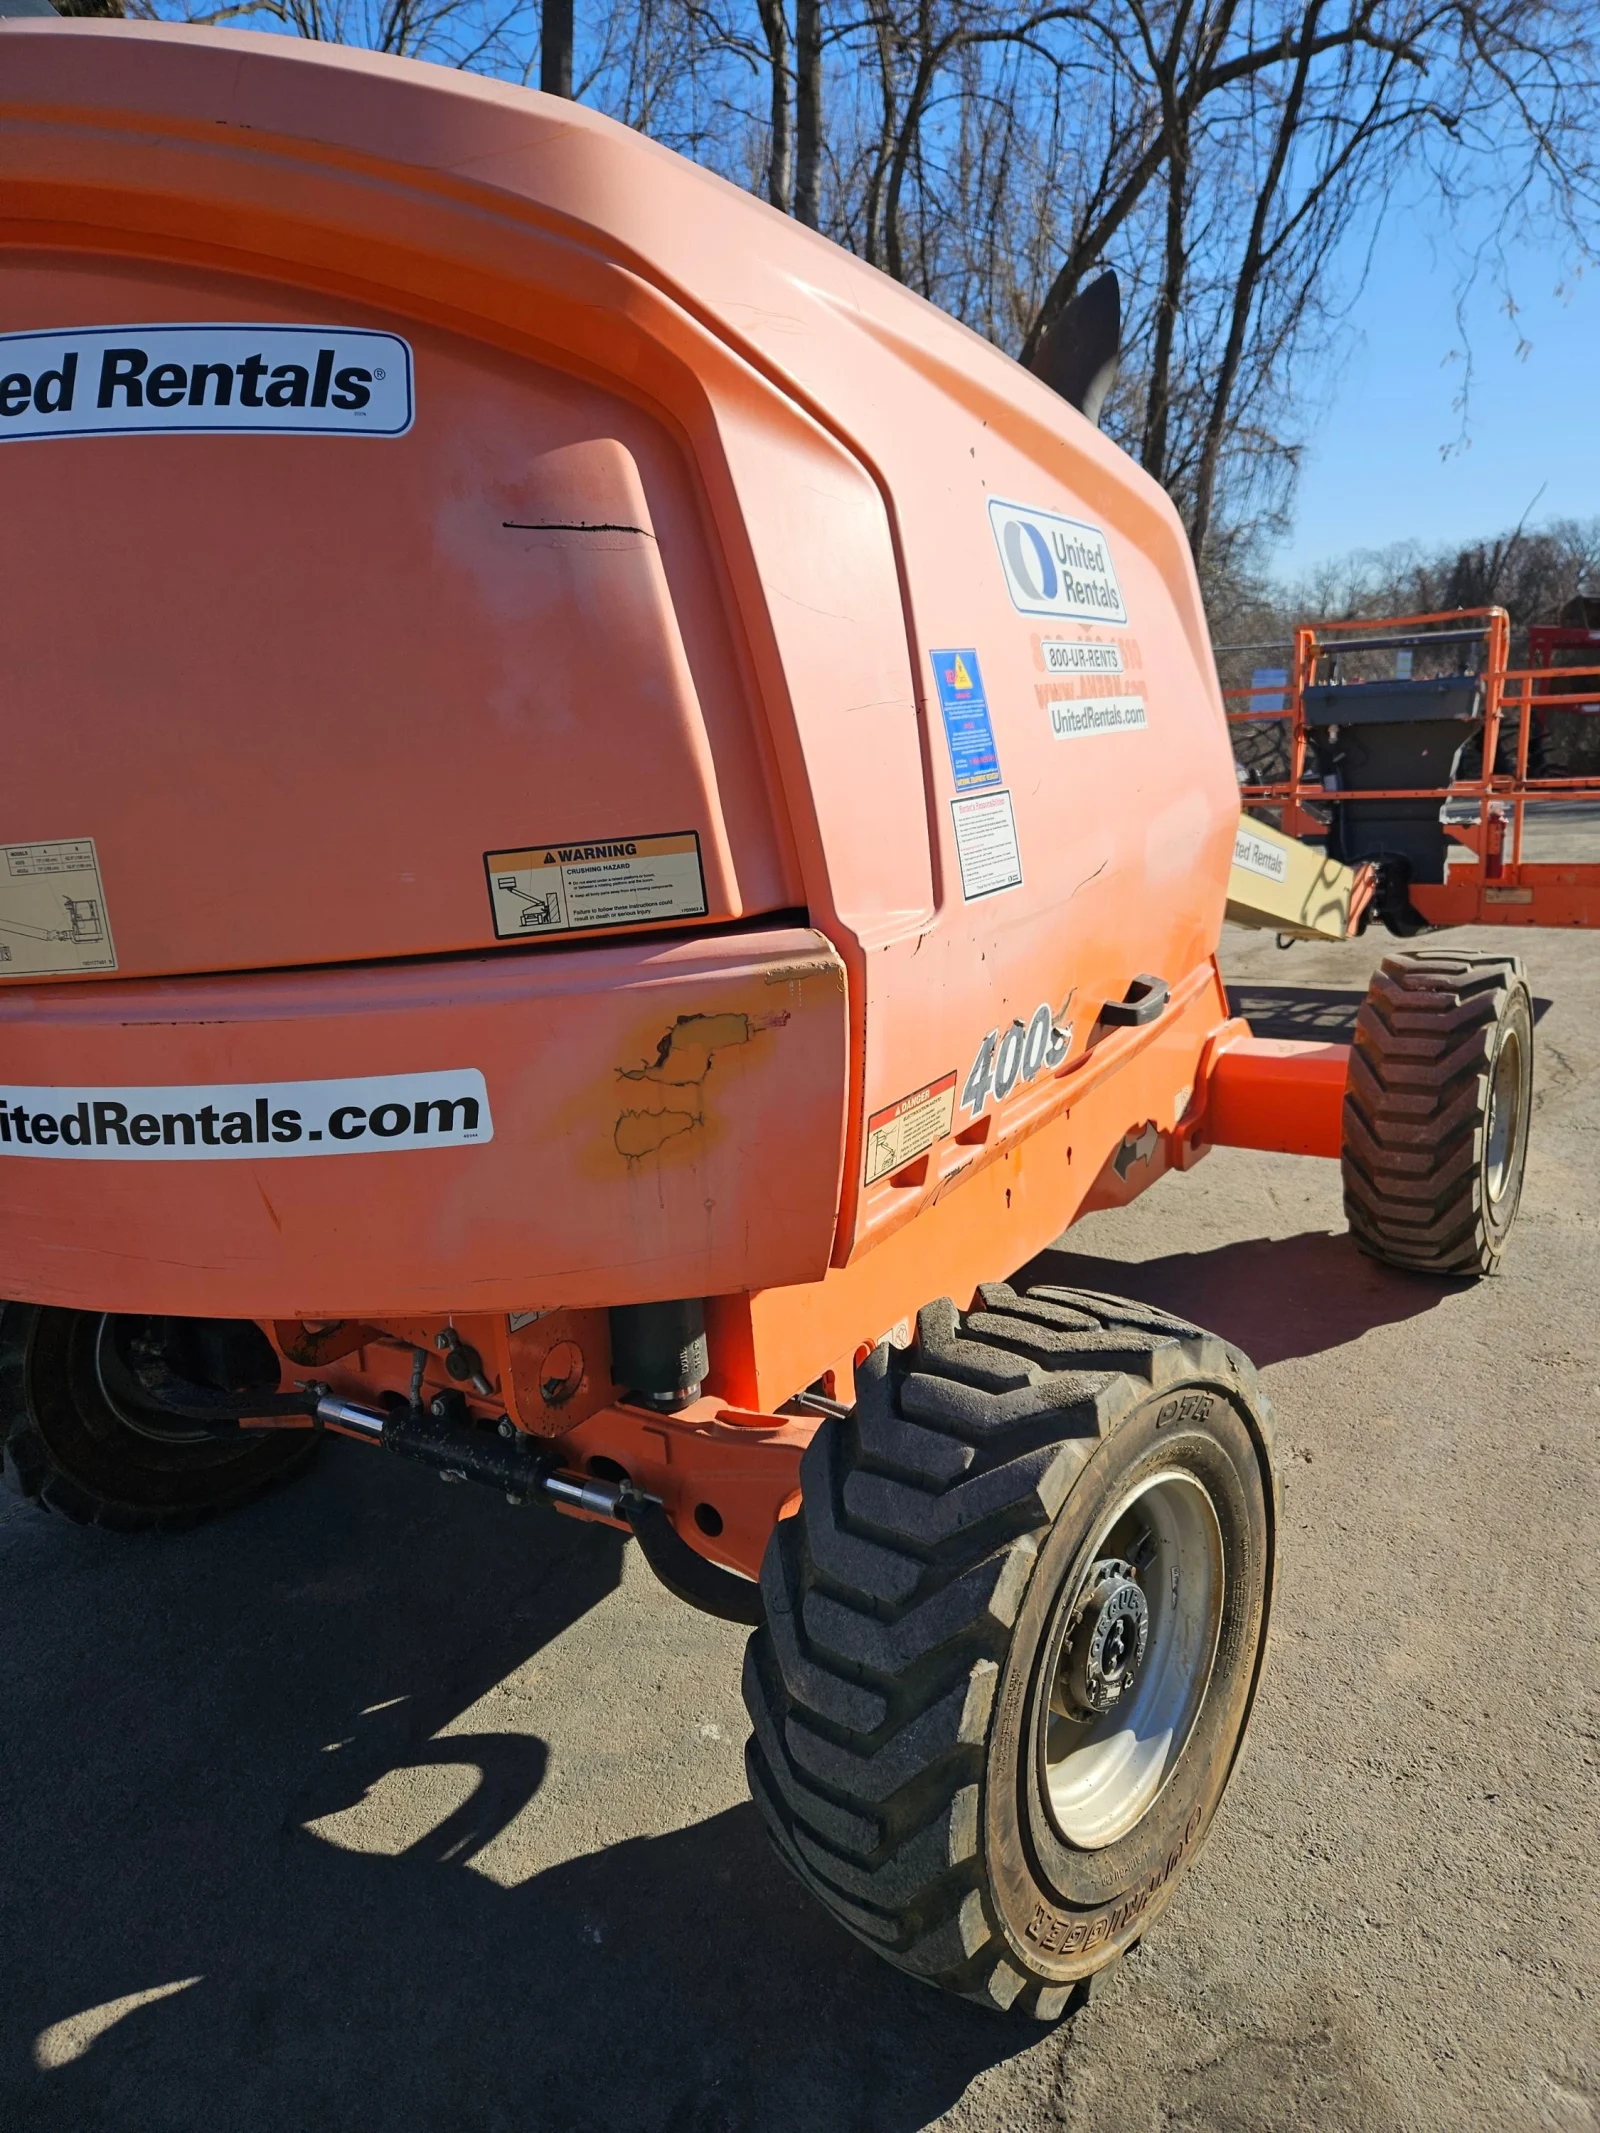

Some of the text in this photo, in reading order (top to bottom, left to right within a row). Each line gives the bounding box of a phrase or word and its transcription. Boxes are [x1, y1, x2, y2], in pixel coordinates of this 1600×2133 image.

[97, 348, 372, 410] Rentals
[1052, 532, 1104, 572] United
[1063, 570, 1120, 609] Rentals
[1049, 648, 1118, 667] 800-UR-RENTS
[1051, 704, 1146, 733] UnitedRentals.com
[558, 843, 637, 862] WARNING
[1252, 844, 1282, 874] Rentals
[566, 863, 630, 875] CRUSHING HAZARD
[573, 908, 591, 916] Failure
[598, 905, 613, 913] follow
[629, 900, 658, 909] instructions
[658, 898, 673, 906] could
[901, 1089, 930, 1113] DANGER
[0, 1096, 480, 1146] itedRentals.com
[1156, 1395, 1214, 1429] OTR
[1024, 1804, 1202, 1954] OUTRIGGER
